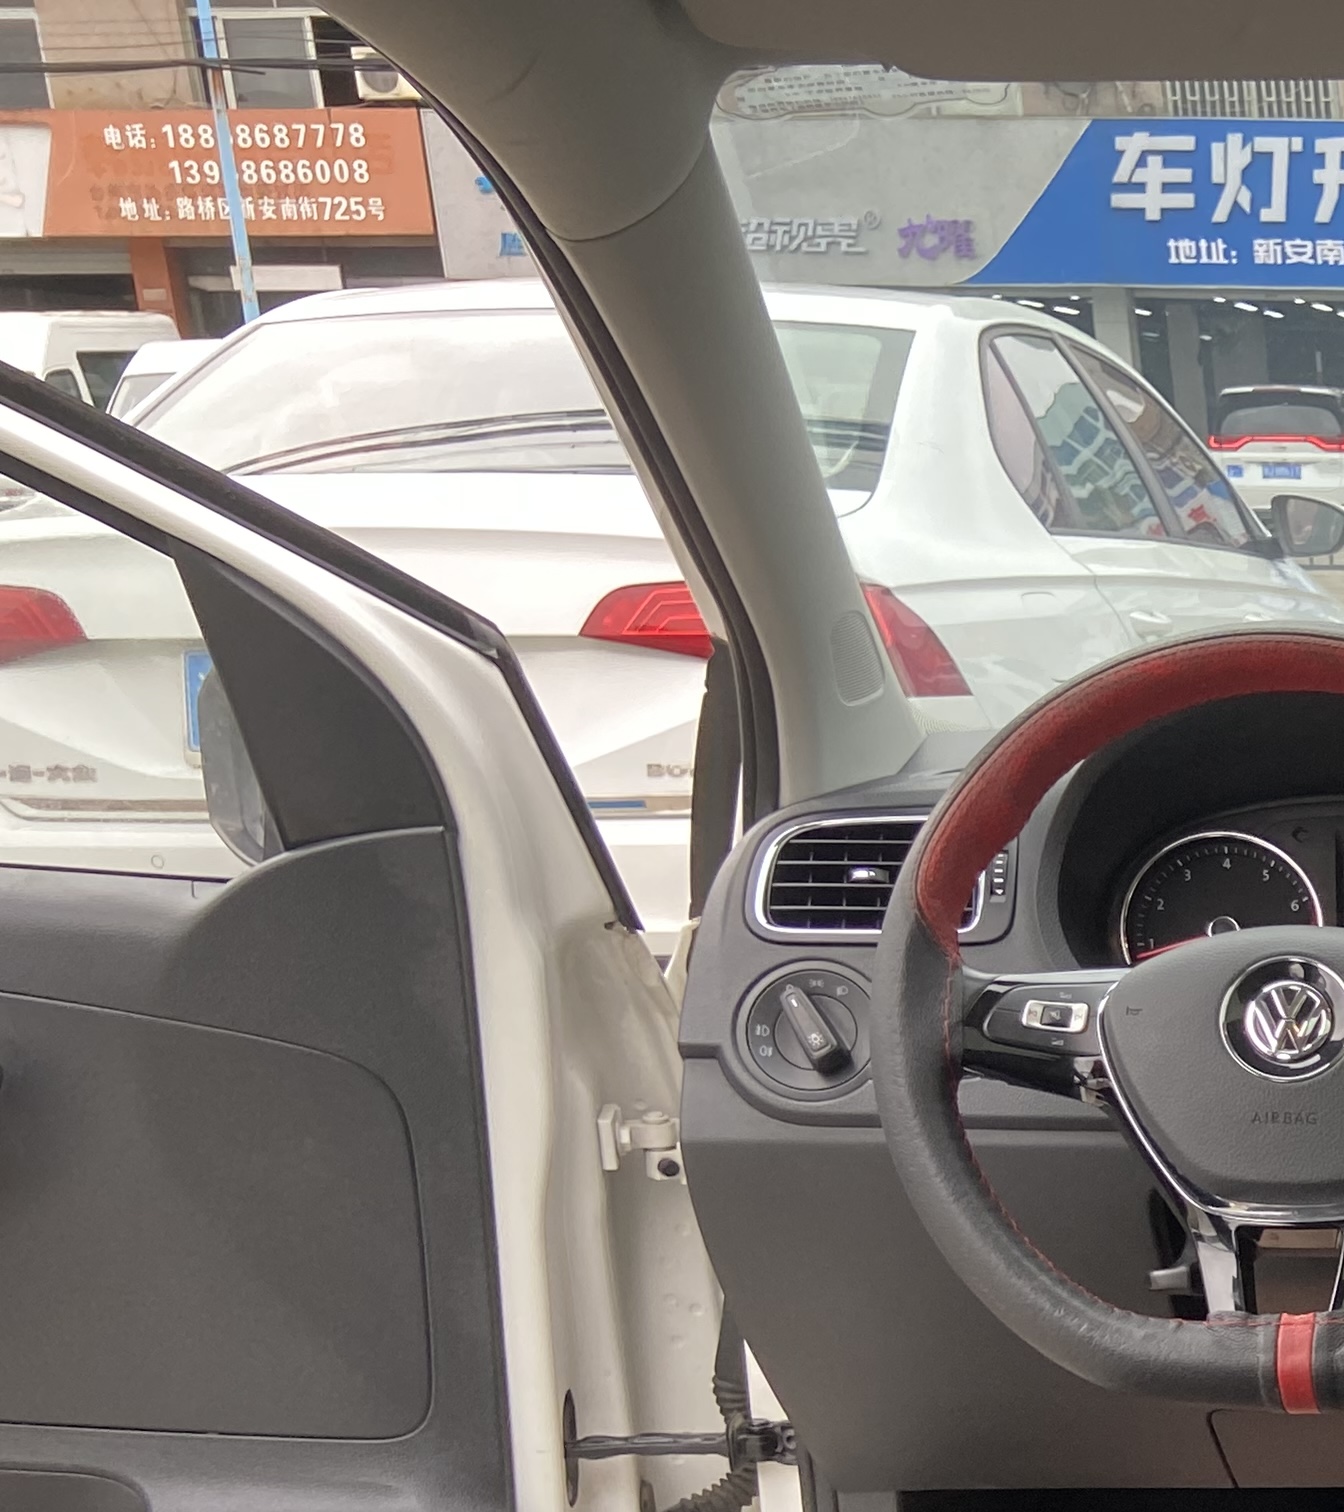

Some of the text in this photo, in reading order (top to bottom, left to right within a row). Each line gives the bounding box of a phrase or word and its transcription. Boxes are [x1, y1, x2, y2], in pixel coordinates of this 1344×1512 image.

[103, 122, 367, 150] 电话：1888687778
[168, 158, 370, 185] 1398686008
[646, 763, 695, 778] BO
[1222, 857, 1231, 870] 4
[1184, 868, 1192, 882] 3
[1262, 868, 1270, 882] 5
[1157, 900, 1165, 911] 2
[1290, 899, 1300, 912] 6
[1251, 1111, 1318, 1125] AIRBAG
